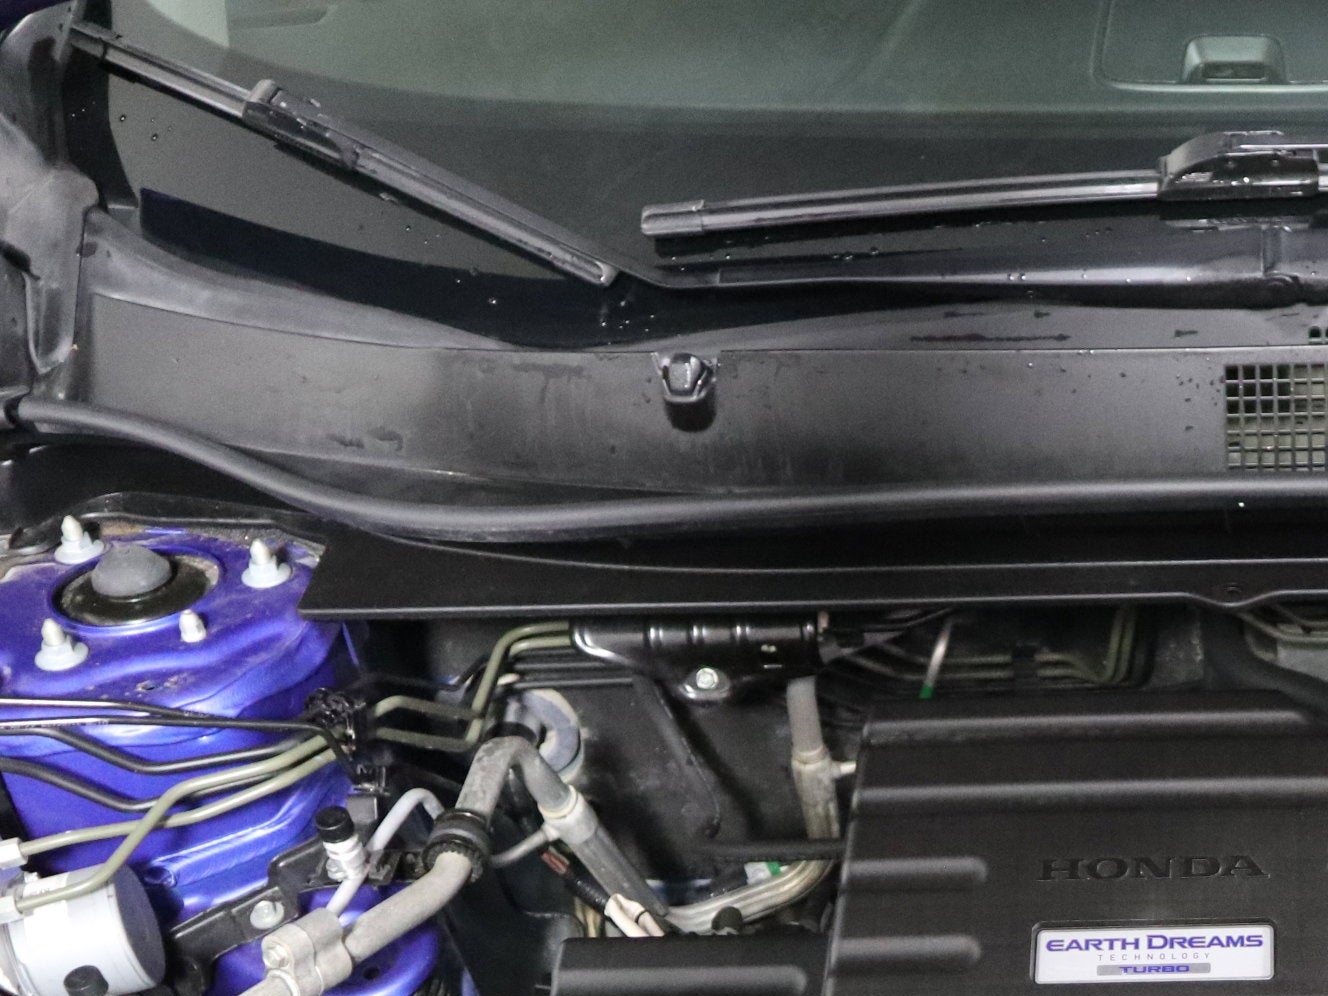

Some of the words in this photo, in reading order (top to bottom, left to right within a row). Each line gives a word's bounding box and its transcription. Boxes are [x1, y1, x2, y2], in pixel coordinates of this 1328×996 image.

[1036, 855, 1271, 881] HONDA
[1046, 937, 1140, 952] EARTH
[1146, 934, 1264, 950] DREAMS
[1098, 952, 1212, 961] TECHNOLOGY
[1119, 964, 1191, 974] TURBO
